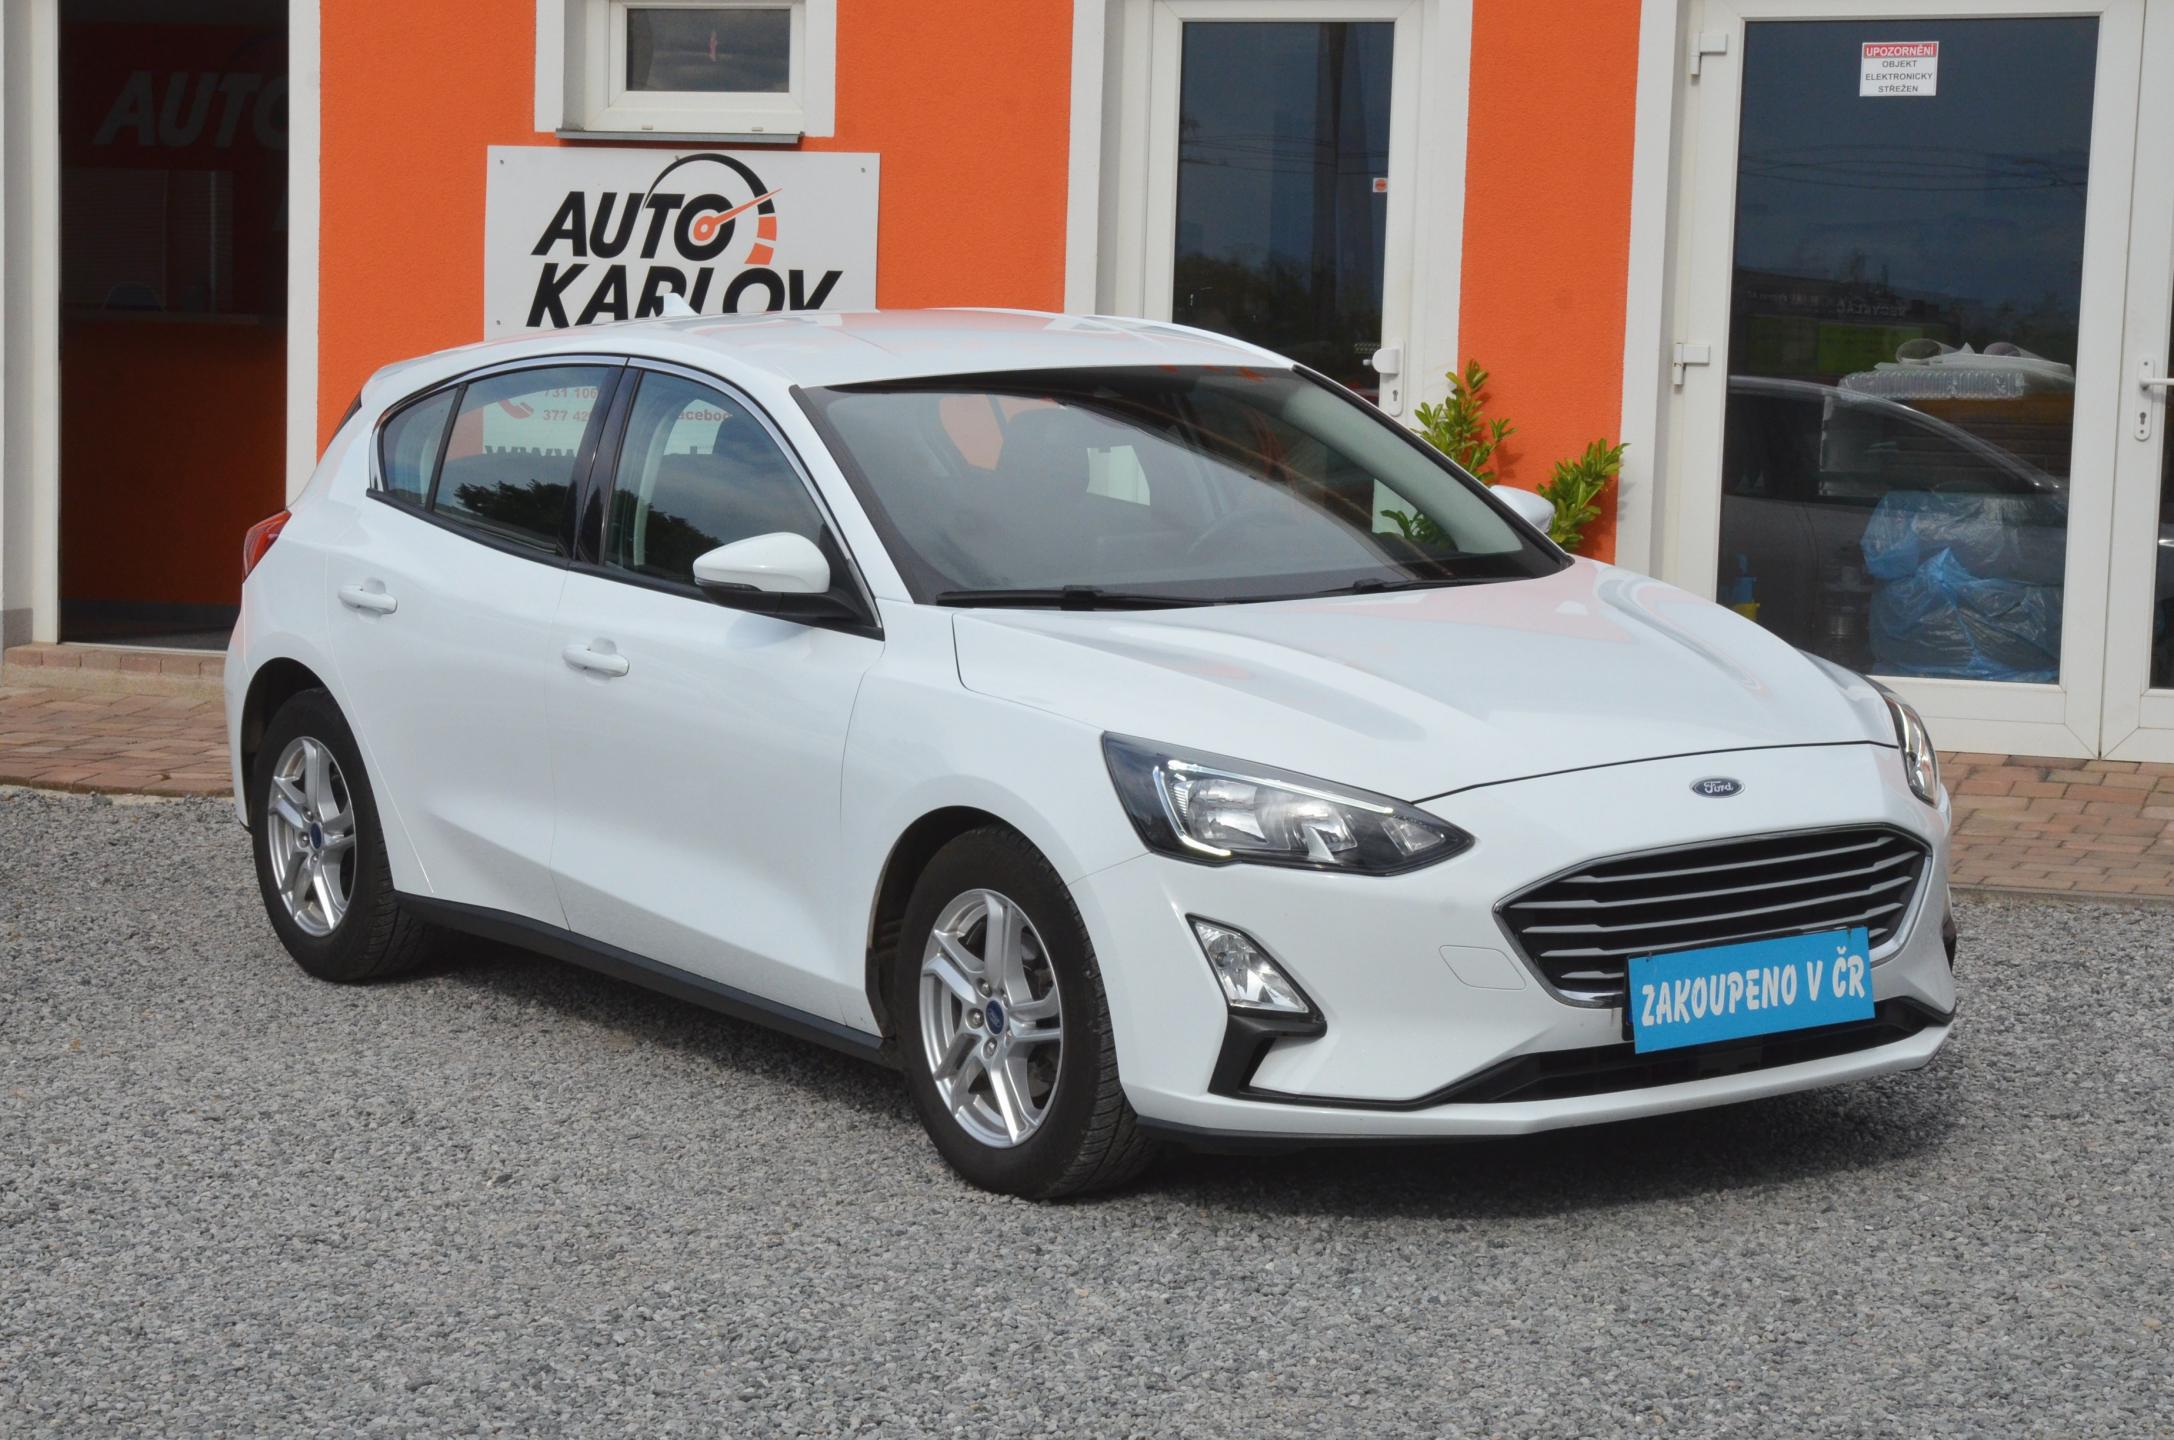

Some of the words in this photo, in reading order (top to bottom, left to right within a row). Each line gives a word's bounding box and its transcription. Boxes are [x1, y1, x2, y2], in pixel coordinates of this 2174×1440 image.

[1866, 44, 1934, 57] UPOZORNĚNÍ
[1882, 60, 1917, 68] OBJEKT
[1865, 73, 1933, 81] ELEKTRONICKY
[1878, 84, 1919, 93] STŘEŽEN
[531, 190, 736, 262] AUTO
[543, 409, 568, 421] 377
[573, 410, 591, 422] 42
[1641, 963, 1797, 1027] ZAKOUPENO
[1807, 959, 1824, 1001] V
[1832, 945, 1866, 999] ČR
